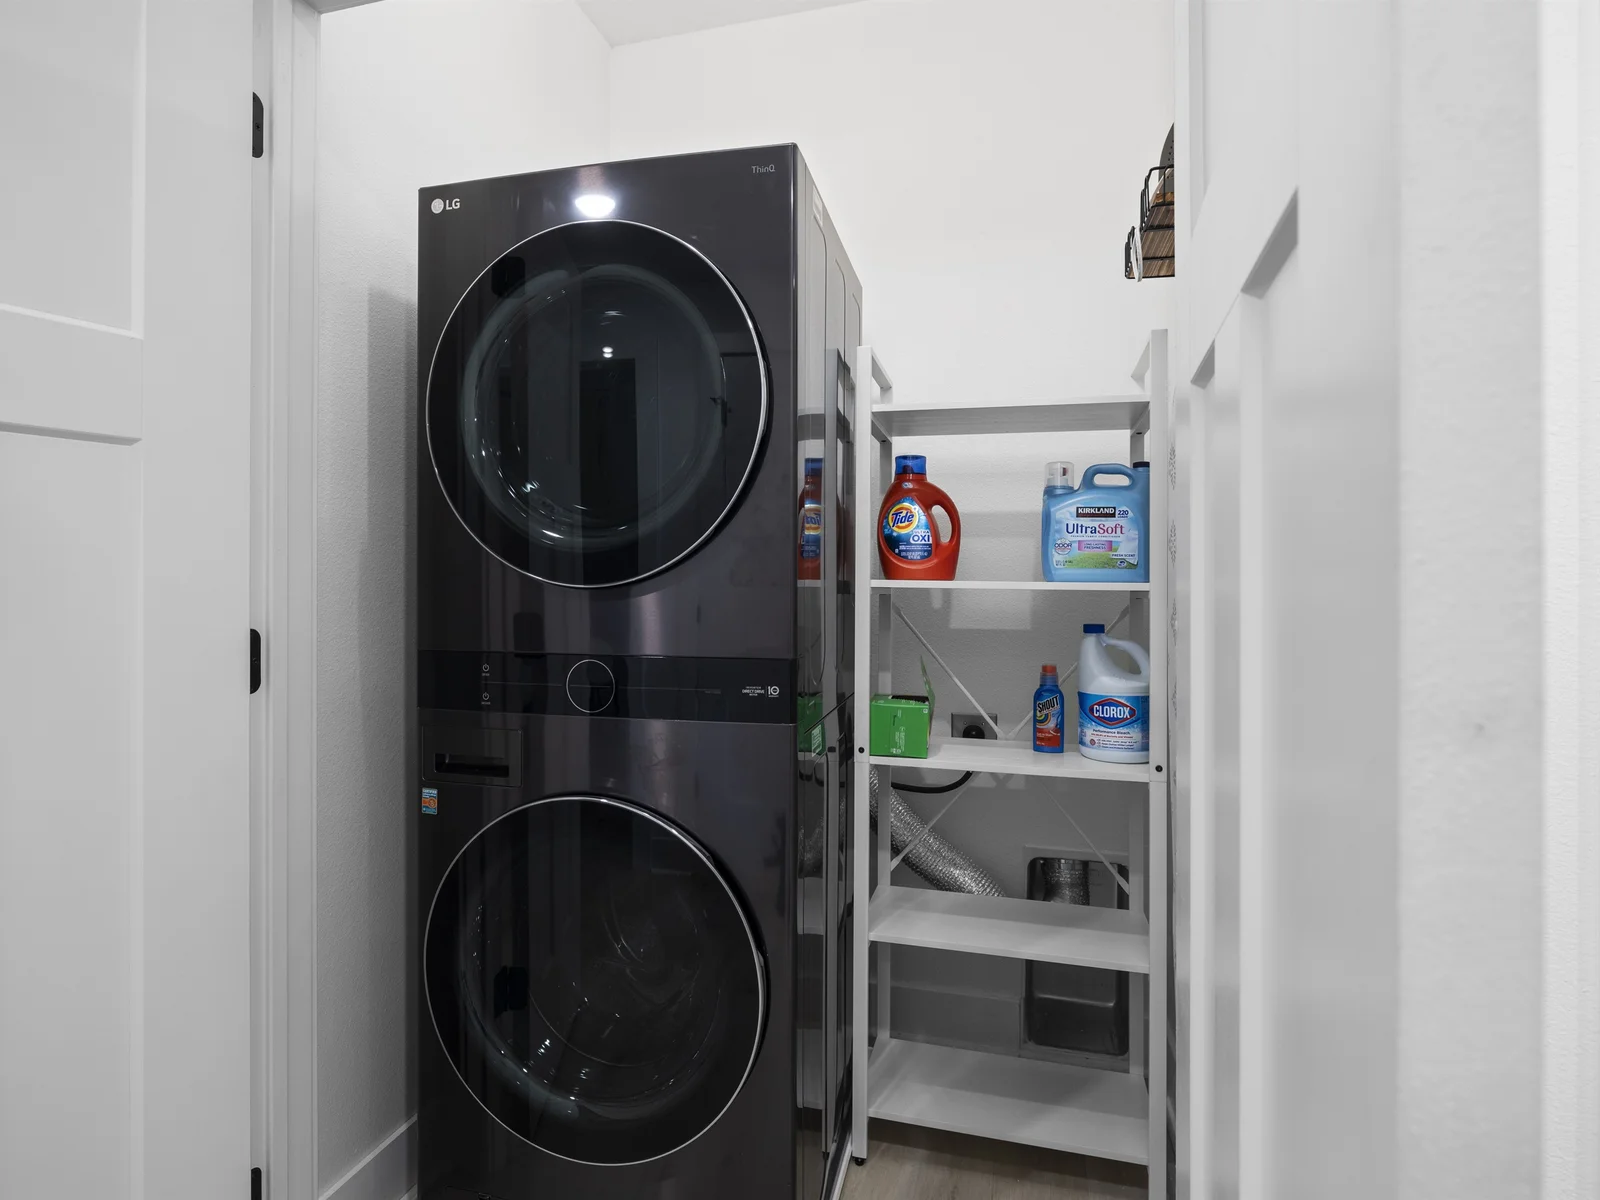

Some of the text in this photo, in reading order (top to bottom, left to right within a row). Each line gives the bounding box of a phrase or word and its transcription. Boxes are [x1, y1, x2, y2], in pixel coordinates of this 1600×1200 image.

[751, 164, 775, 174] ThinQ
[445, 198, 460, 210] LG
[891, 510, 914, 528] Tide
[1065, 522, 1125, 535] UltraSoft
[912, 534, 930, 543] OXI
[1037, 695, 1059, 713] SHOUT
[1093, 705, 1130, 718] CLOROX
